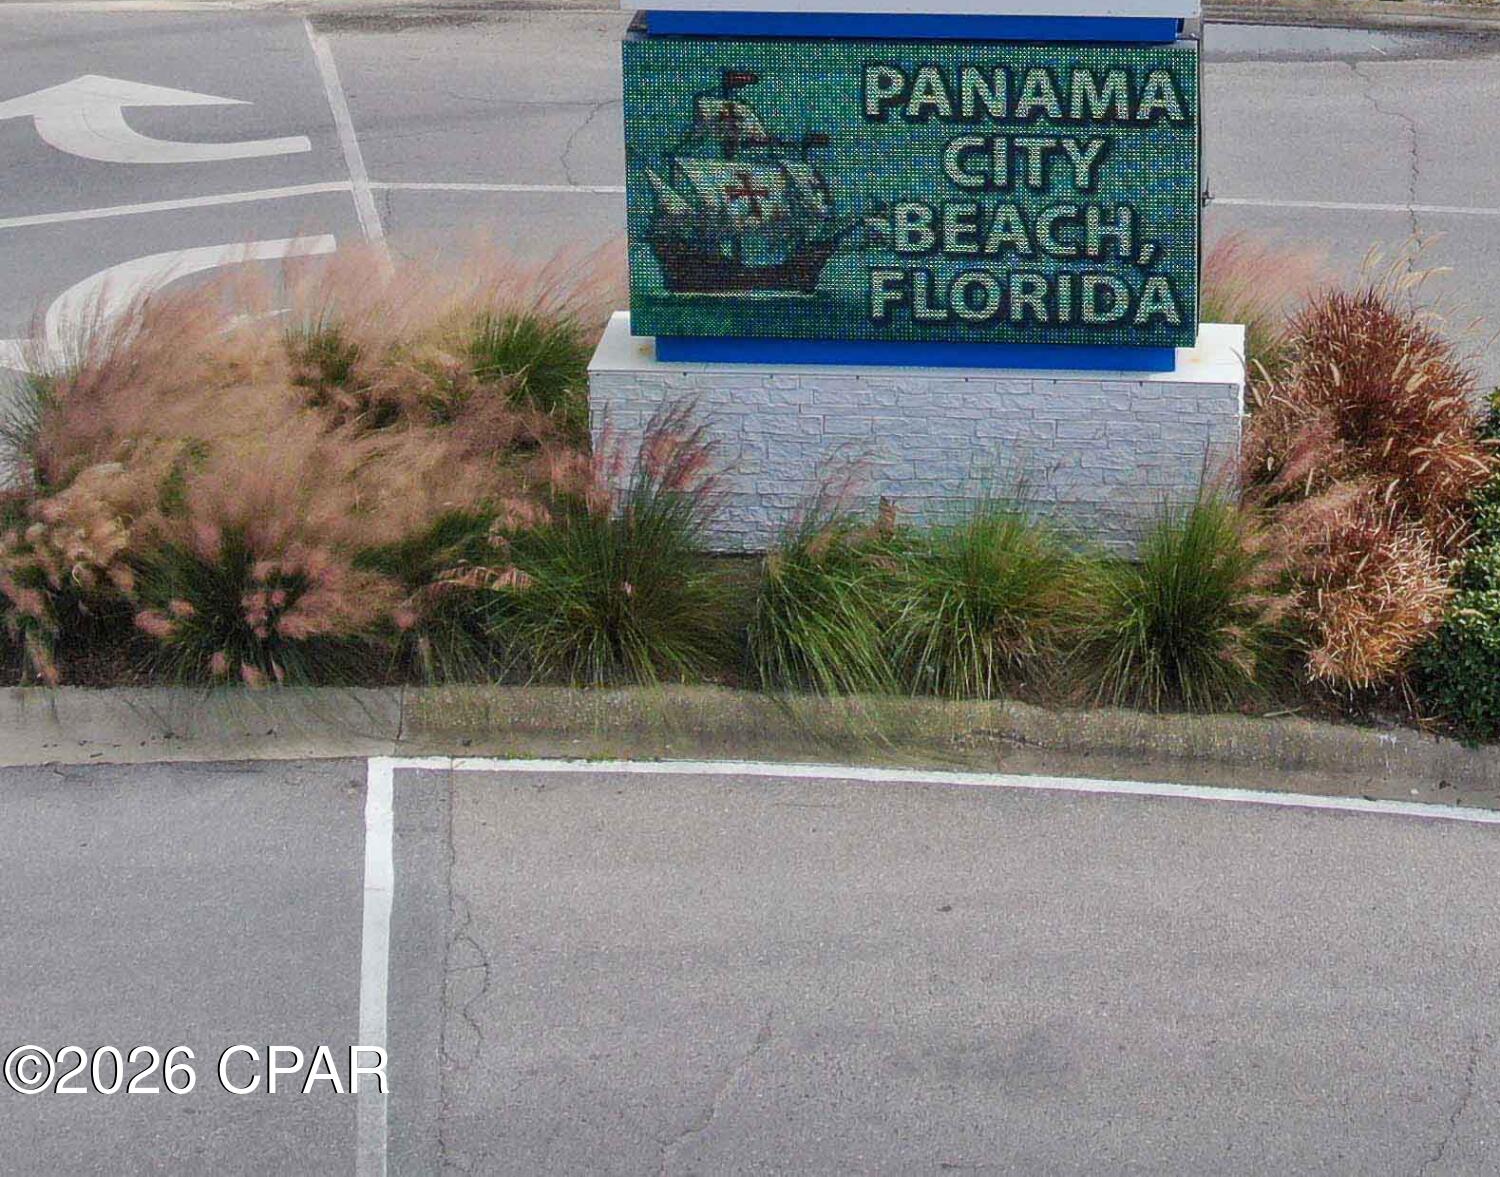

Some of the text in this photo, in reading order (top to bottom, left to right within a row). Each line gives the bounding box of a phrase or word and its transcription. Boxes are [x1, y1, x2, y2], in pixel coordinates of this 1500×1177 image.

[863, 65, 1185, 122] PANAMA
[944, 136, 1106, 189] CITY
[896, 203, 1157, 266] BEACH,
[870, 270, 1181, 325] FLORIDA
